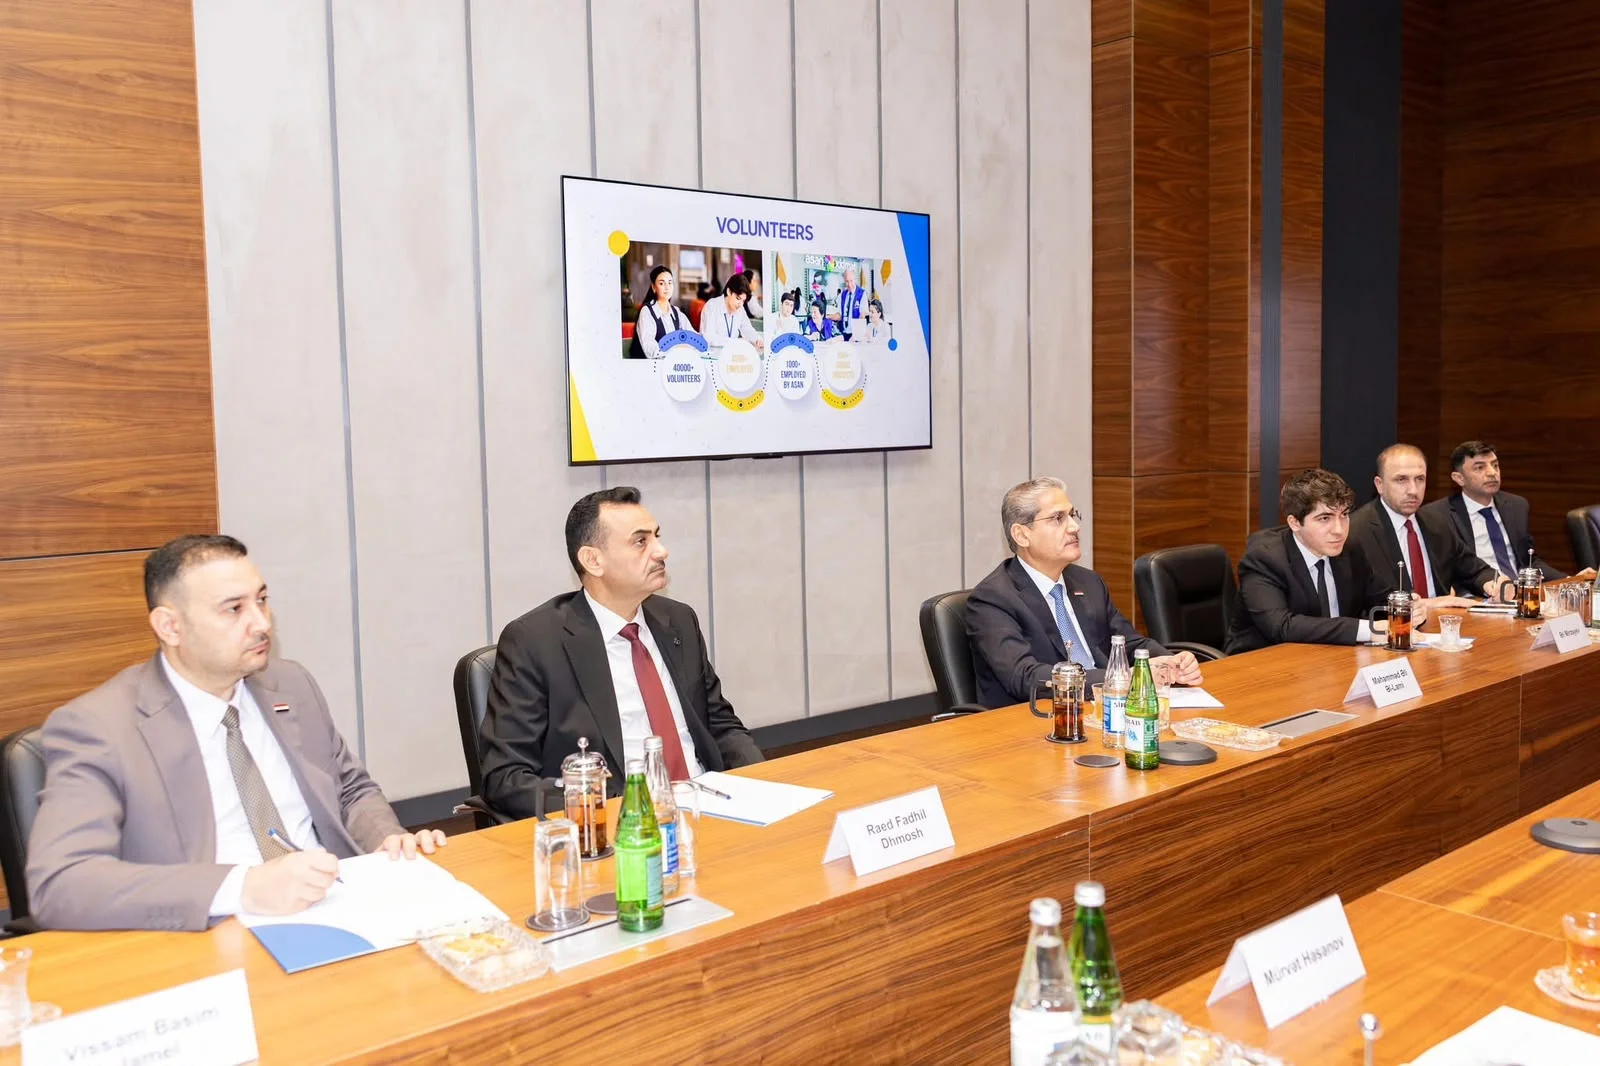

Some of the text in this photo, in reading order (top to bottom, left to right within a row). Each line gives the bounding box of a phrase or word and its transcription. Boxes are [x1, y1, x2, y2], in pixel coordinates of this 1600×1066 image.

[716, 216, 814, 241] VOLUNTEERS
[672, 363, 694, 373] 40000+
[785, 360, 801, 369] 1000+
[666, 373, 701, 384] VOLUNTEERS
[780, 370, 806, 379] EMPLOYED
[783, 380, 804, 389] BY ASAN
[866, 808, 927, 836] Raed Fadhil
[880, 827, 924, 849] Dhmosh
[153, 1006, 219, 1036] Basim
